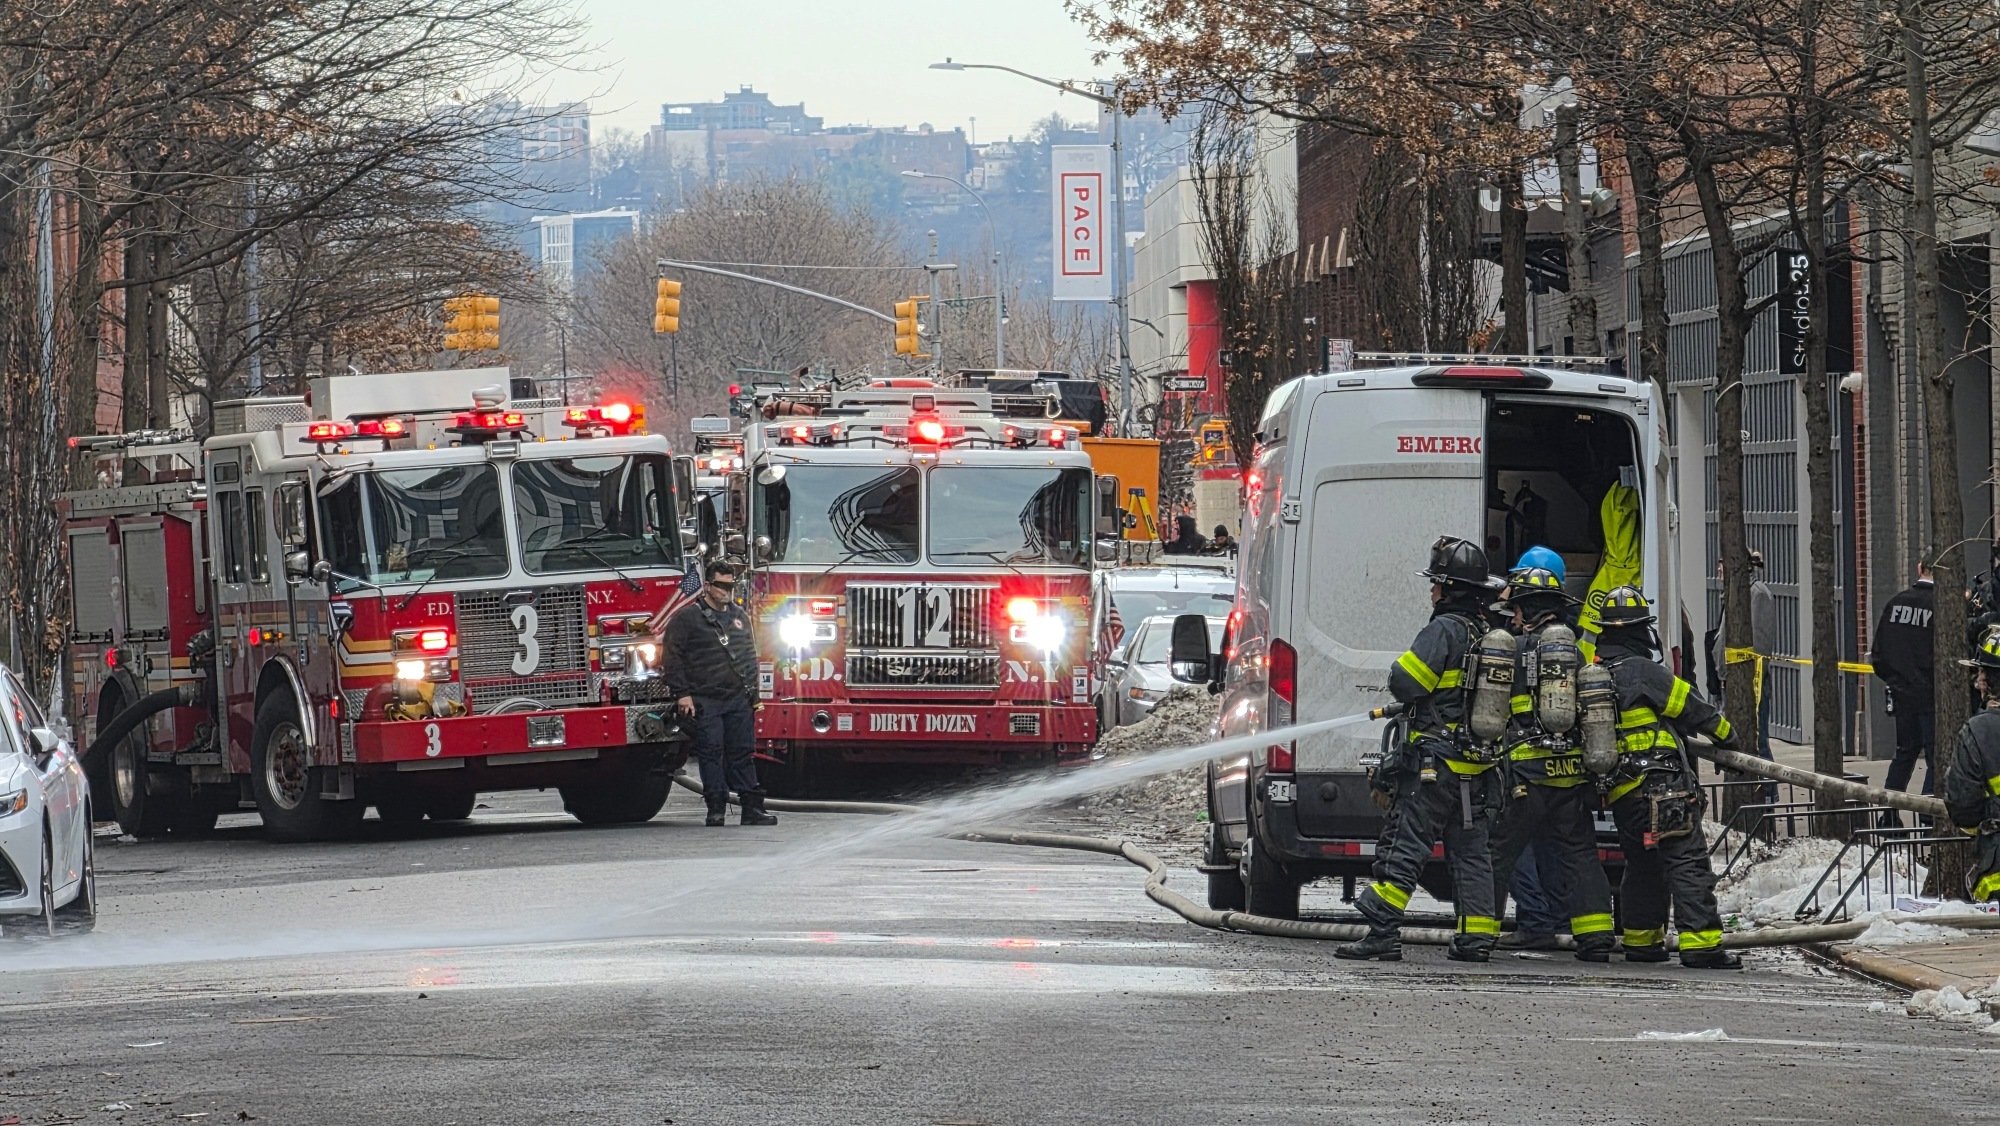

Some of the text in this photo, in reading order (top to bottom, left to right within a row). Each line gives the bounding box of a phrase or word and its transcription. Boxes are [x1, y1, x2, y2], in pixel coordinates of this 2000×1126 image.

[1073, 187, 1091, 261] PACE
[427, 602, 452, 616] F.D.
[587, 590, 614, 605] N.Y.
[897, 587, 951, 648] 12
[1888, 605, 1933, 628] FDNY
[511, 605, 540, 676] 3
[870, 713, 920, 733] DIRTY
[925, 713, 977, 733] DOZEN
[424, 723, 442, 757] 3
[1545, 758, 1582, 777] SANC
